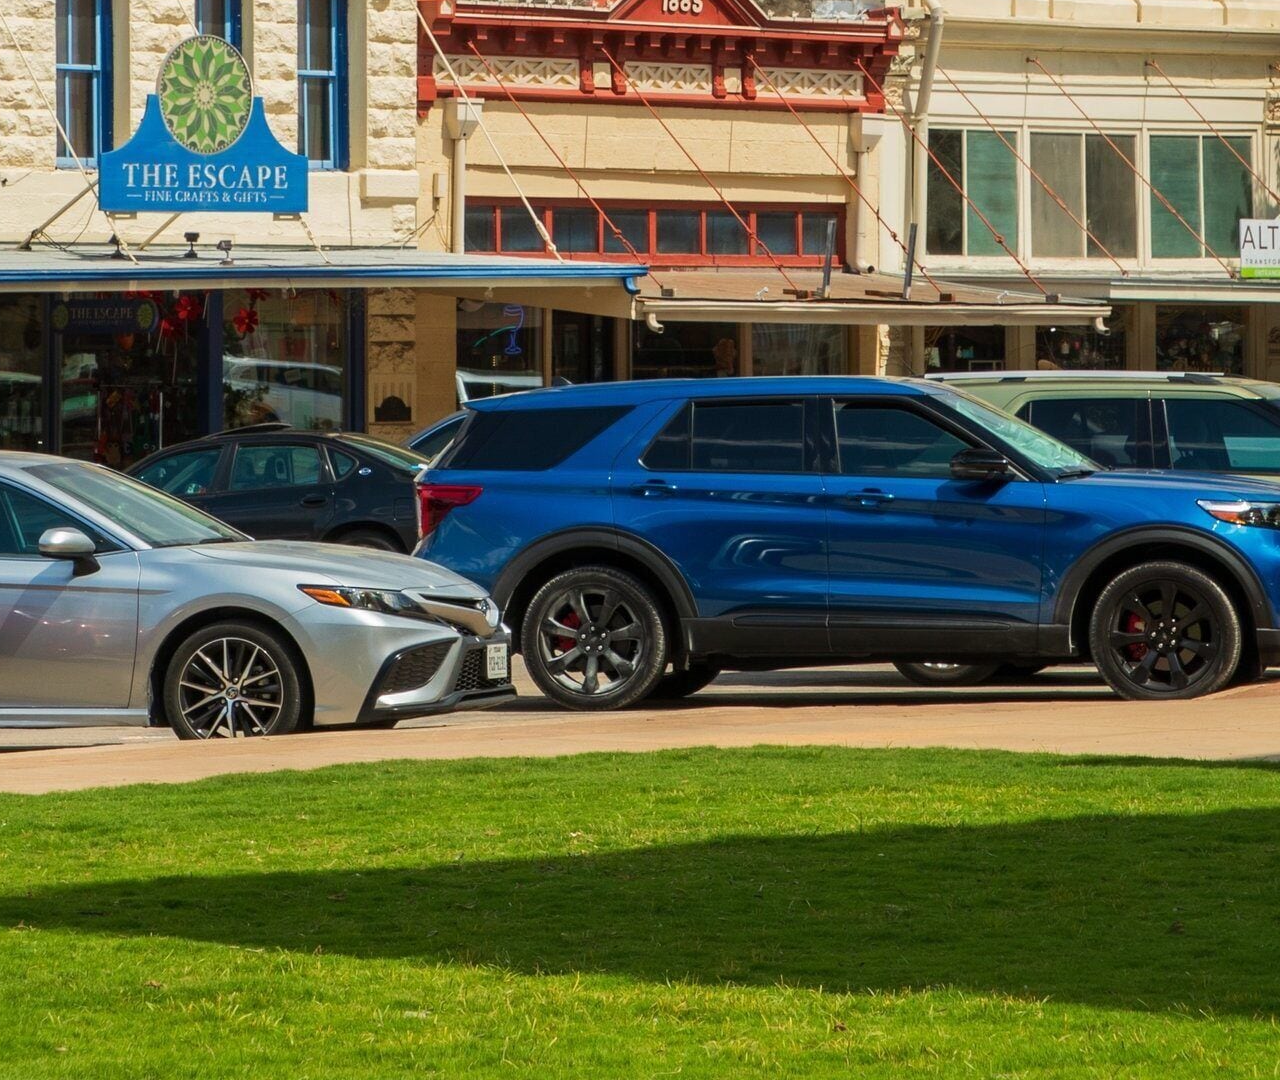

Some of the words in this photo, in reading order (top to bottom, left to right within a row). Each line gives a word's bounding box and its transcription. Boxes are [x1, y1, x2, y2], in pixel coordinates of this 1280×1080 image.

[122, 163, 179, 188] THE
[187, 164, 288, 189] ESCAPE
[144, 190, 172, 202] FINE
[175, 191, 219, 202] CRAFTS
[222, 191, 231, 203] &
[233, 191, 267, 203] GIFTS
[70, 308, 93, 319] THE
